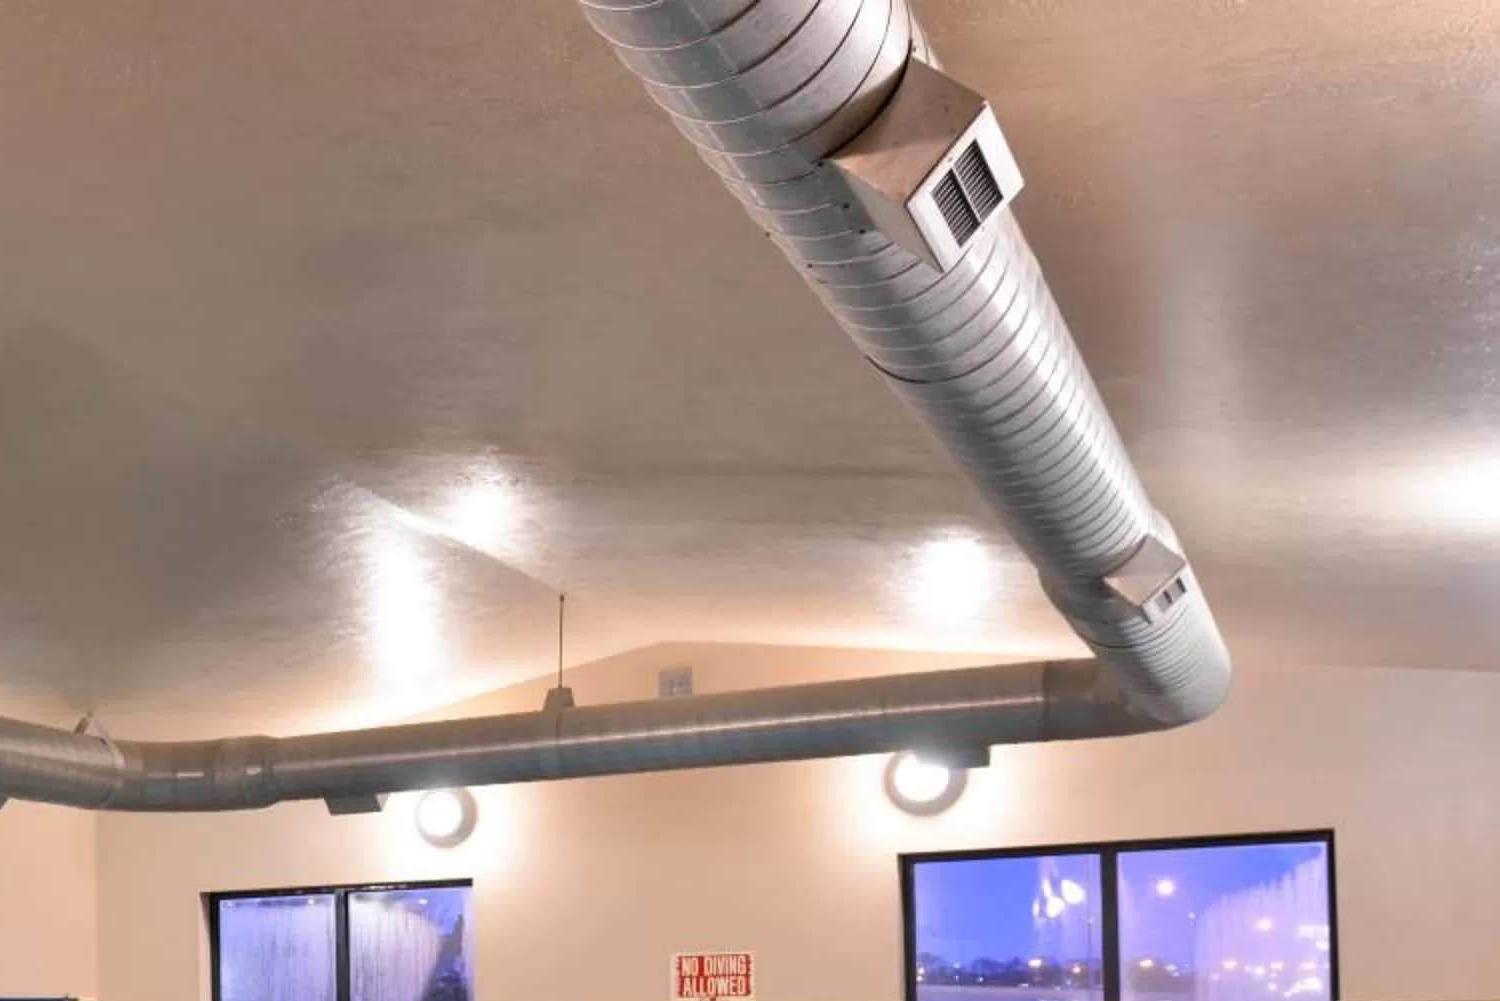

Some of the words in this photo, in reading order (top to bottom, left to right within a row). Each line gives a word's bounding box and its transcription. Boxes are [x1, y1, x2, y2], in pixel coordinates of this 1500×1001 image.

[681, 957, 698, 976] NO
[704, 955, 746, 976] DIVING
[683, 976, 746, 997] ALLOWED
